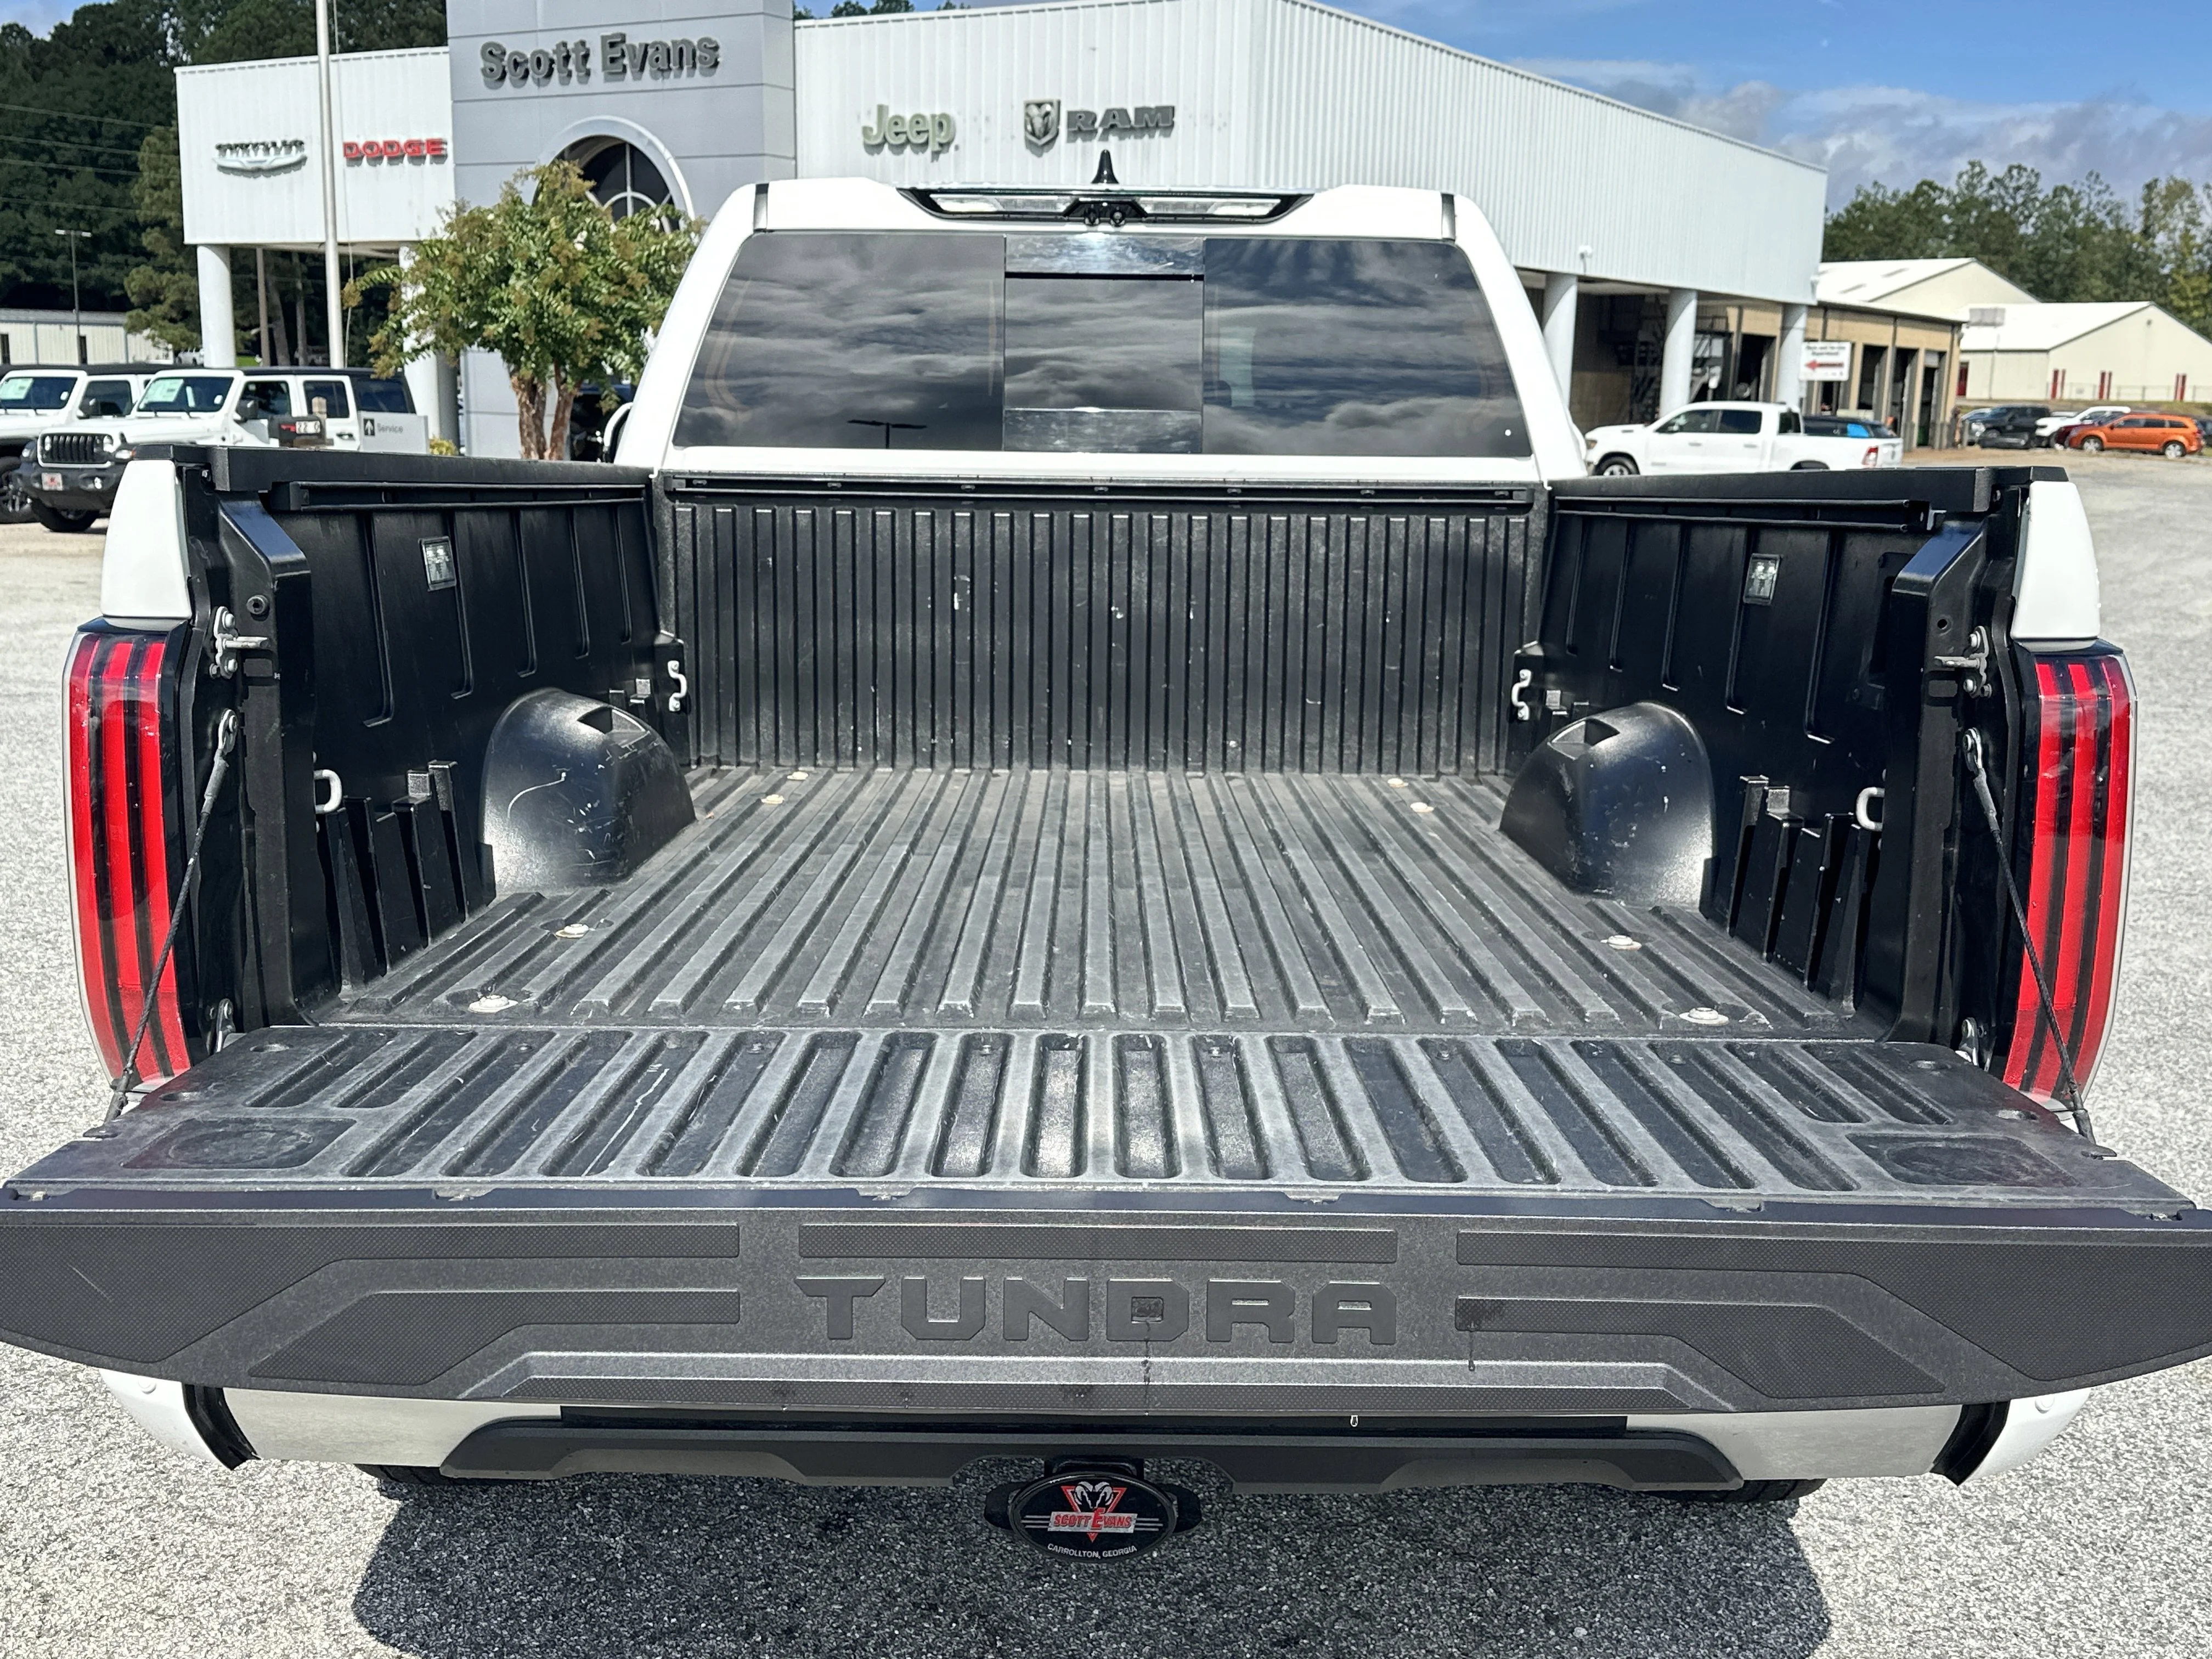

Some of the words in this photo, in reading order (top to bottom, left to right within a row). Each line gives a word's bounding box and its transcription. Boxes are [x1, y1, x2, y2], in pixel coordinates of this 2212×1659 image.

[480, 40, 591, 81] Scott
[601, 32, 720, 74] Evans
[862, 104, 956, 151] Jeep
[1066, 105, 1175, 131] RAM
[343, 138, 448, 158] DODGE
[794, 1276, 1397, 1345] TUNDRA
[1054, 1514, 1091, 1527] SCOTT
[1091, 1508, 1132, 1530] EVANS
[1048, 1544, 1101, 1559] CARROLLTON,
[1103, 1545, 1137, 1558] GEORGIA
